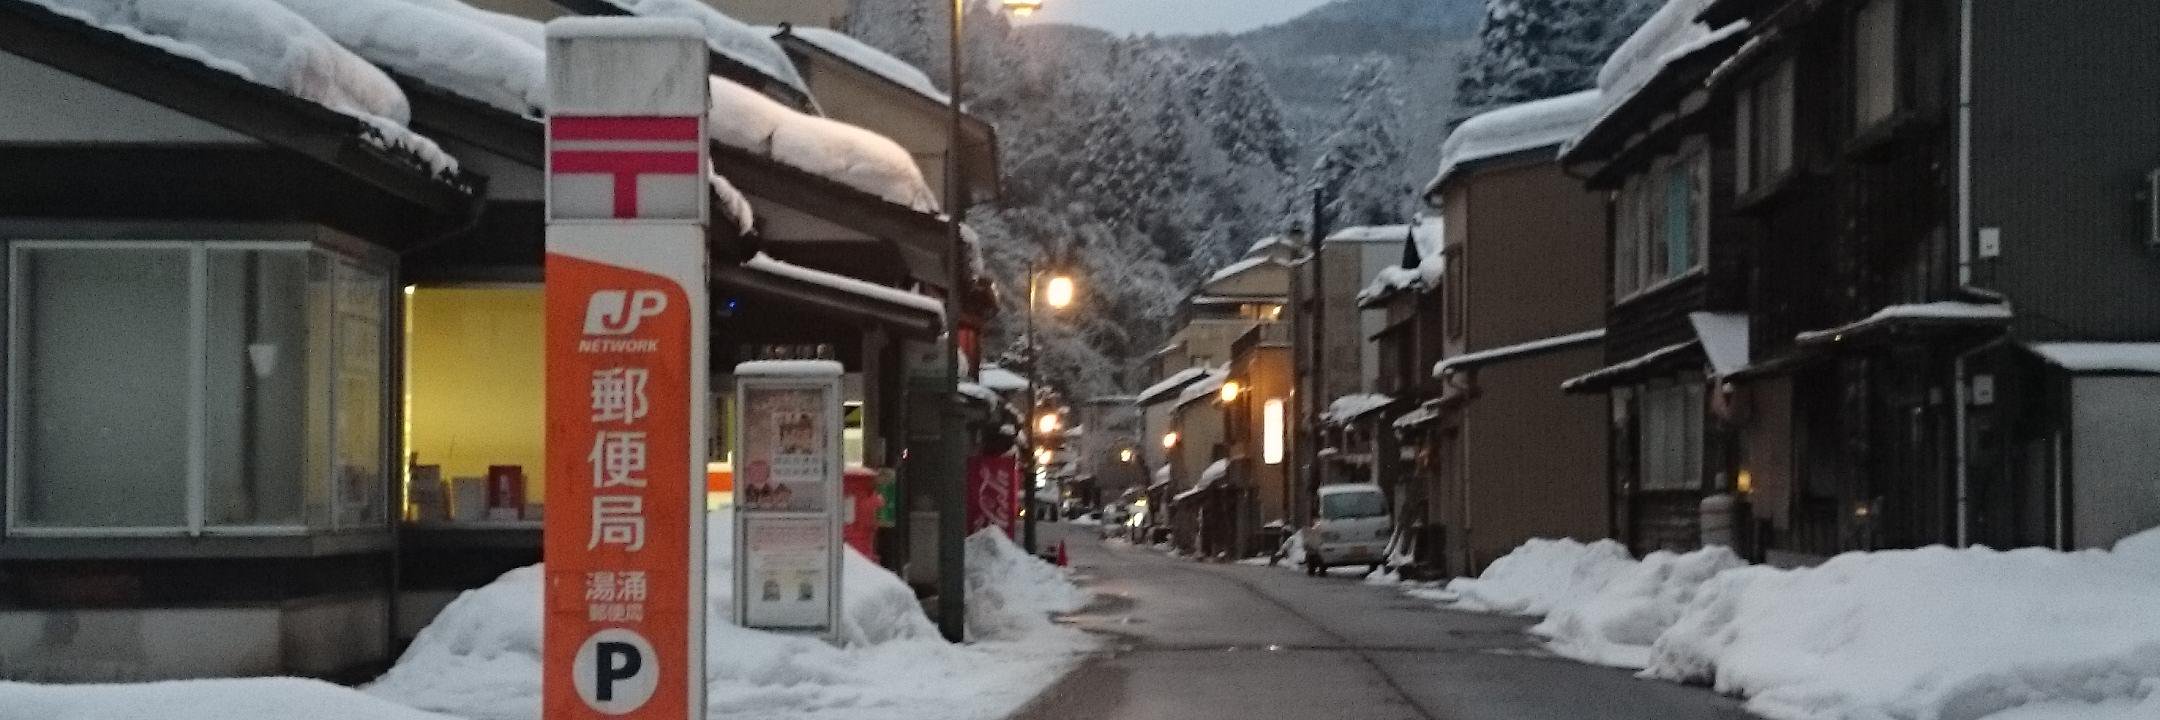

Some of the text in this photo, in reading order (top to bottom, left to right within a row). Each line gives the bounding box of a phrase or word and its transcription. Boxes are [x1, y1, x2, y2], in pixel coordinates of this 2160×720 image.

[583, 289, 668, 335] JP
[579, 340, 660, 352] NETWORK
[587, 367, 649, 552] 郵便局
[585, 570, 647, 601] 湯涌
[596, 642, 641, 701] P
